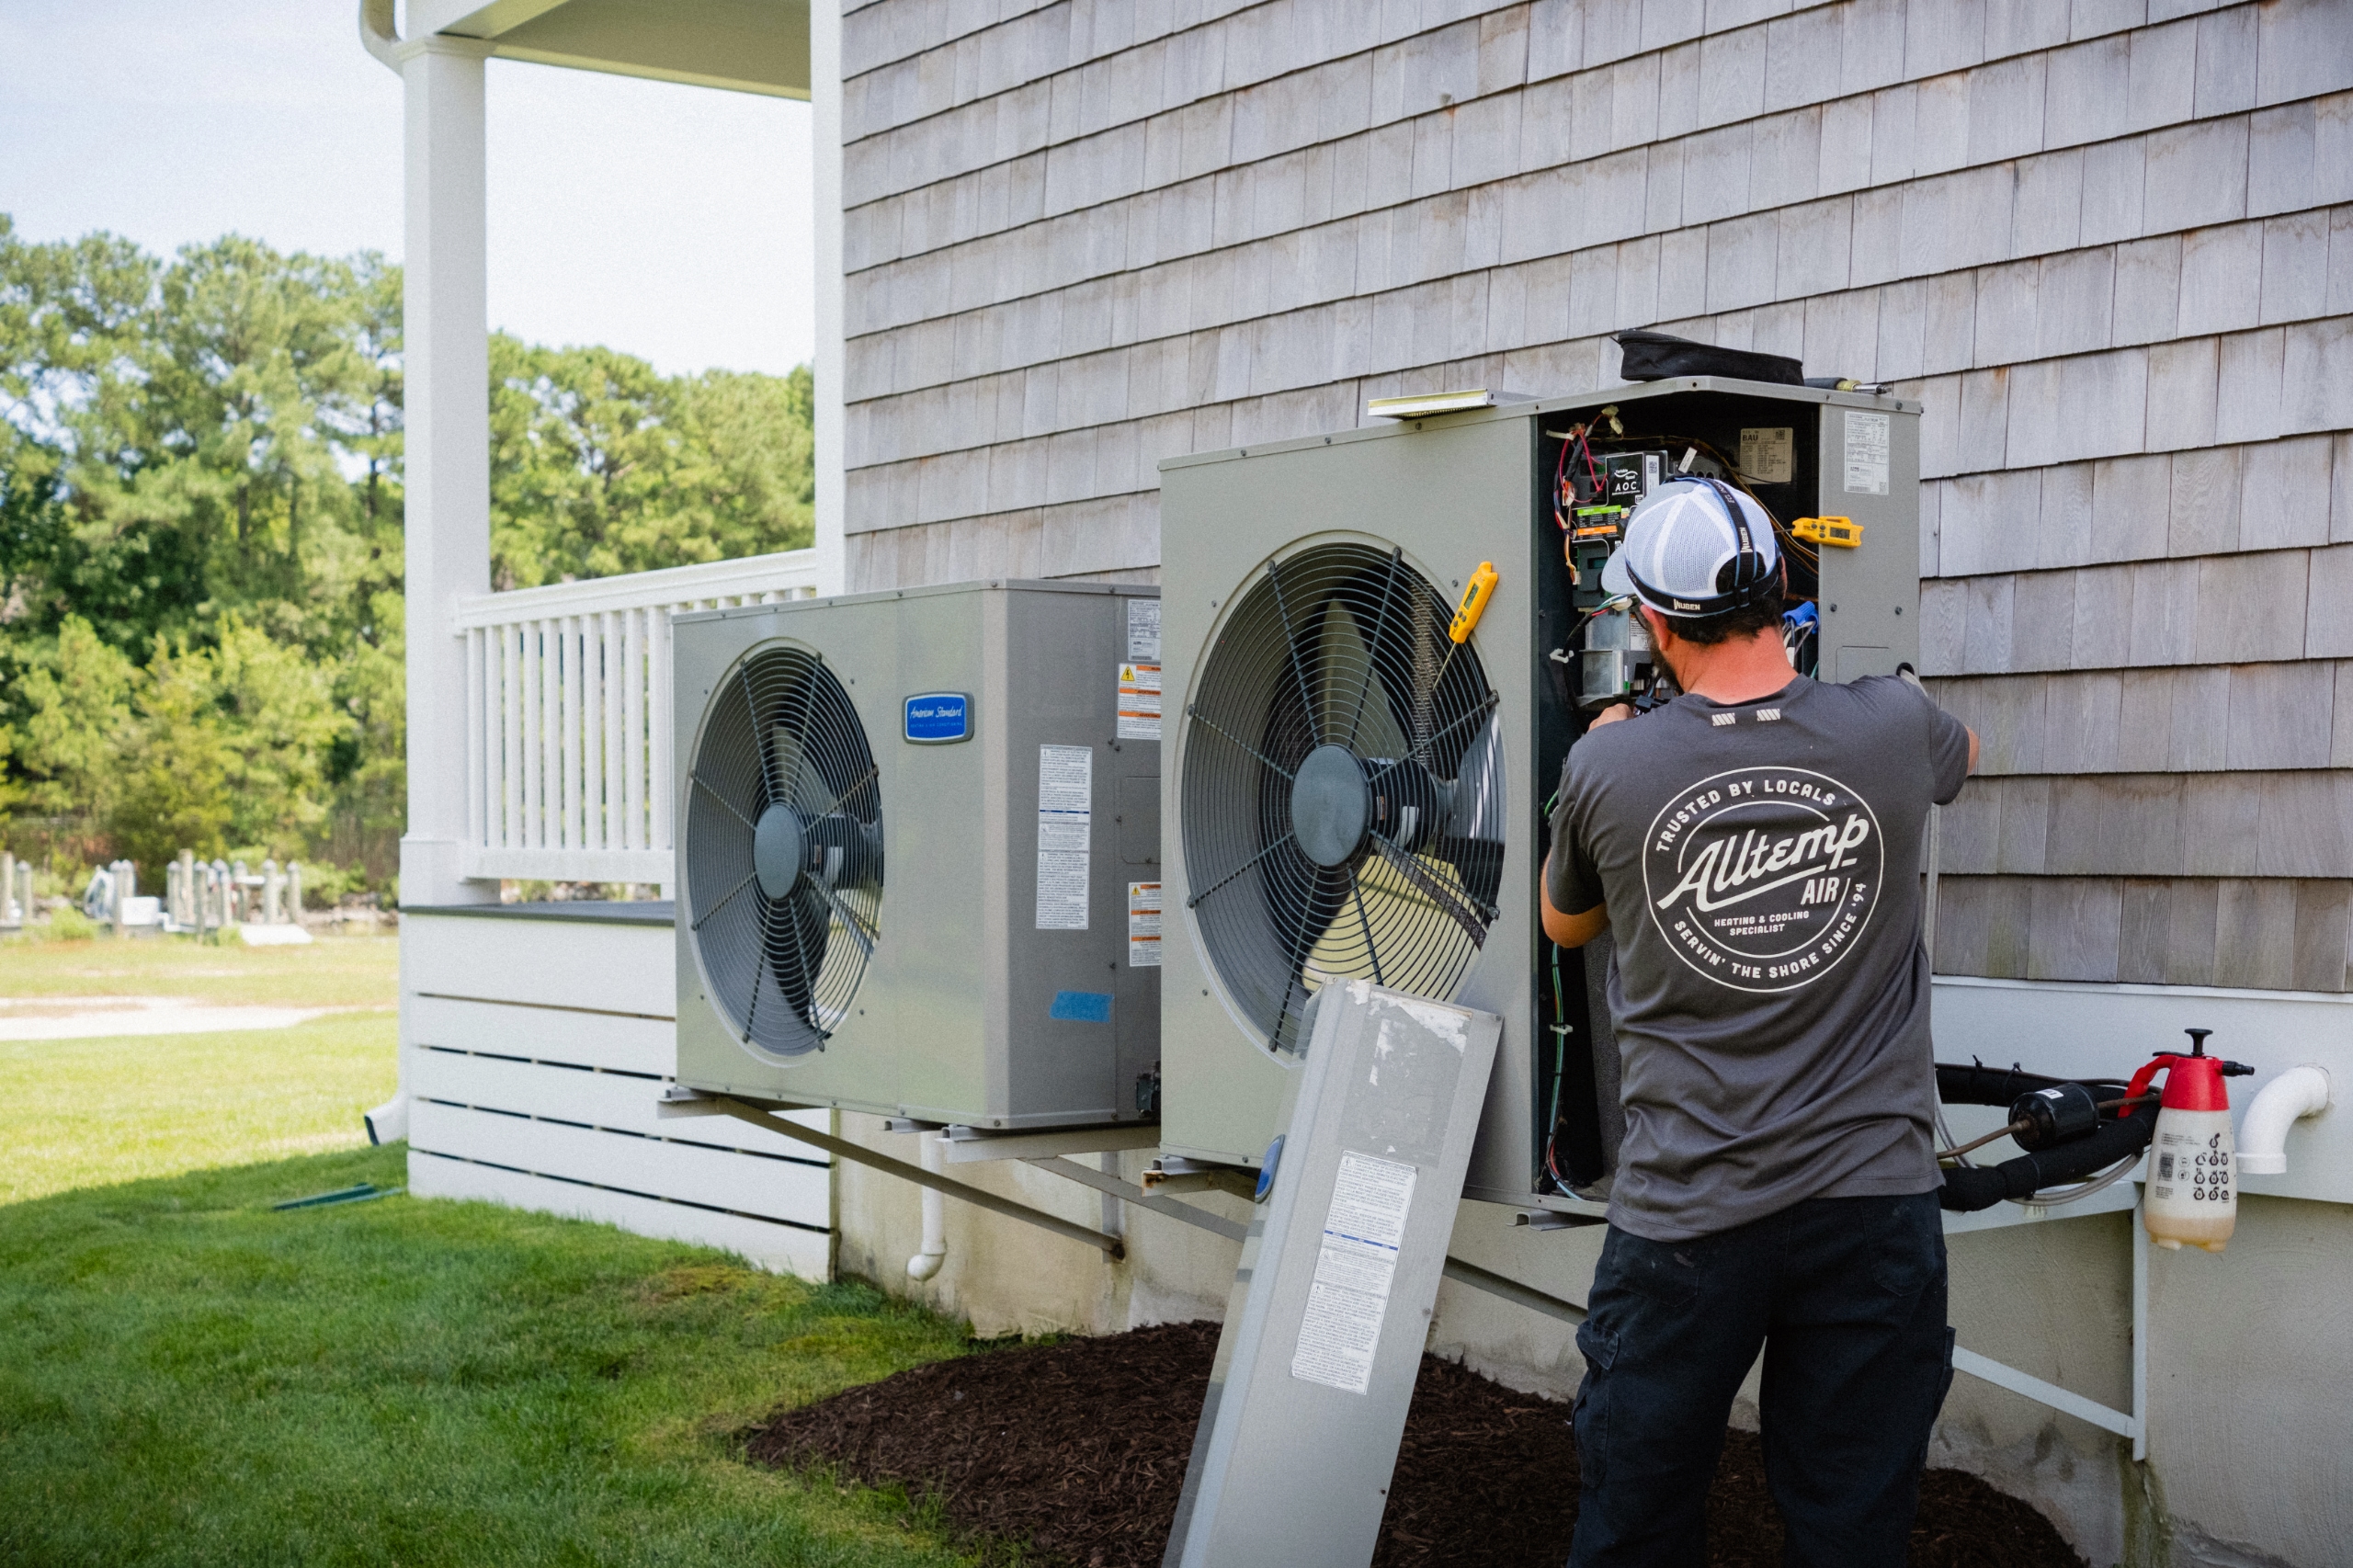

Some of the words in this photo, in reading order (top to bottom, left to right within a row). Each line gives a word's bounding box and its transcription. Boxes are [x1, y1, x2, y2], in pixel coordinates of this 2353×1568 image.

[1615, 481, 1637, 492] AOC
[911, 706, 934, 719] American
[936, 705, 963, 717] Standard
[1656, 790, 1721, 851] TRUSTED
[1729, 781, 1753, 797] BY
[1764, 779, 1836, 806] LOCALS
[1657, 813, 1870, 913] Alltemp
[1800, 877, 1840, 905] AIR
[1714, 915, 1756, 927] HEATING
[1758, 915, 1766, 924] &
[1768, 910, 1810, 923] COOLING
[1674, 920, 1726, 966] SERVIN'
[1732, 962, 1762, 979] THE
[1768, 951, 1820, 979] SHORE
[1822, 912, 1857, 954] SINCE
[1851, 883, 1867, 908] '94
[1729, 923, 1786, 937] SPECIALIST
